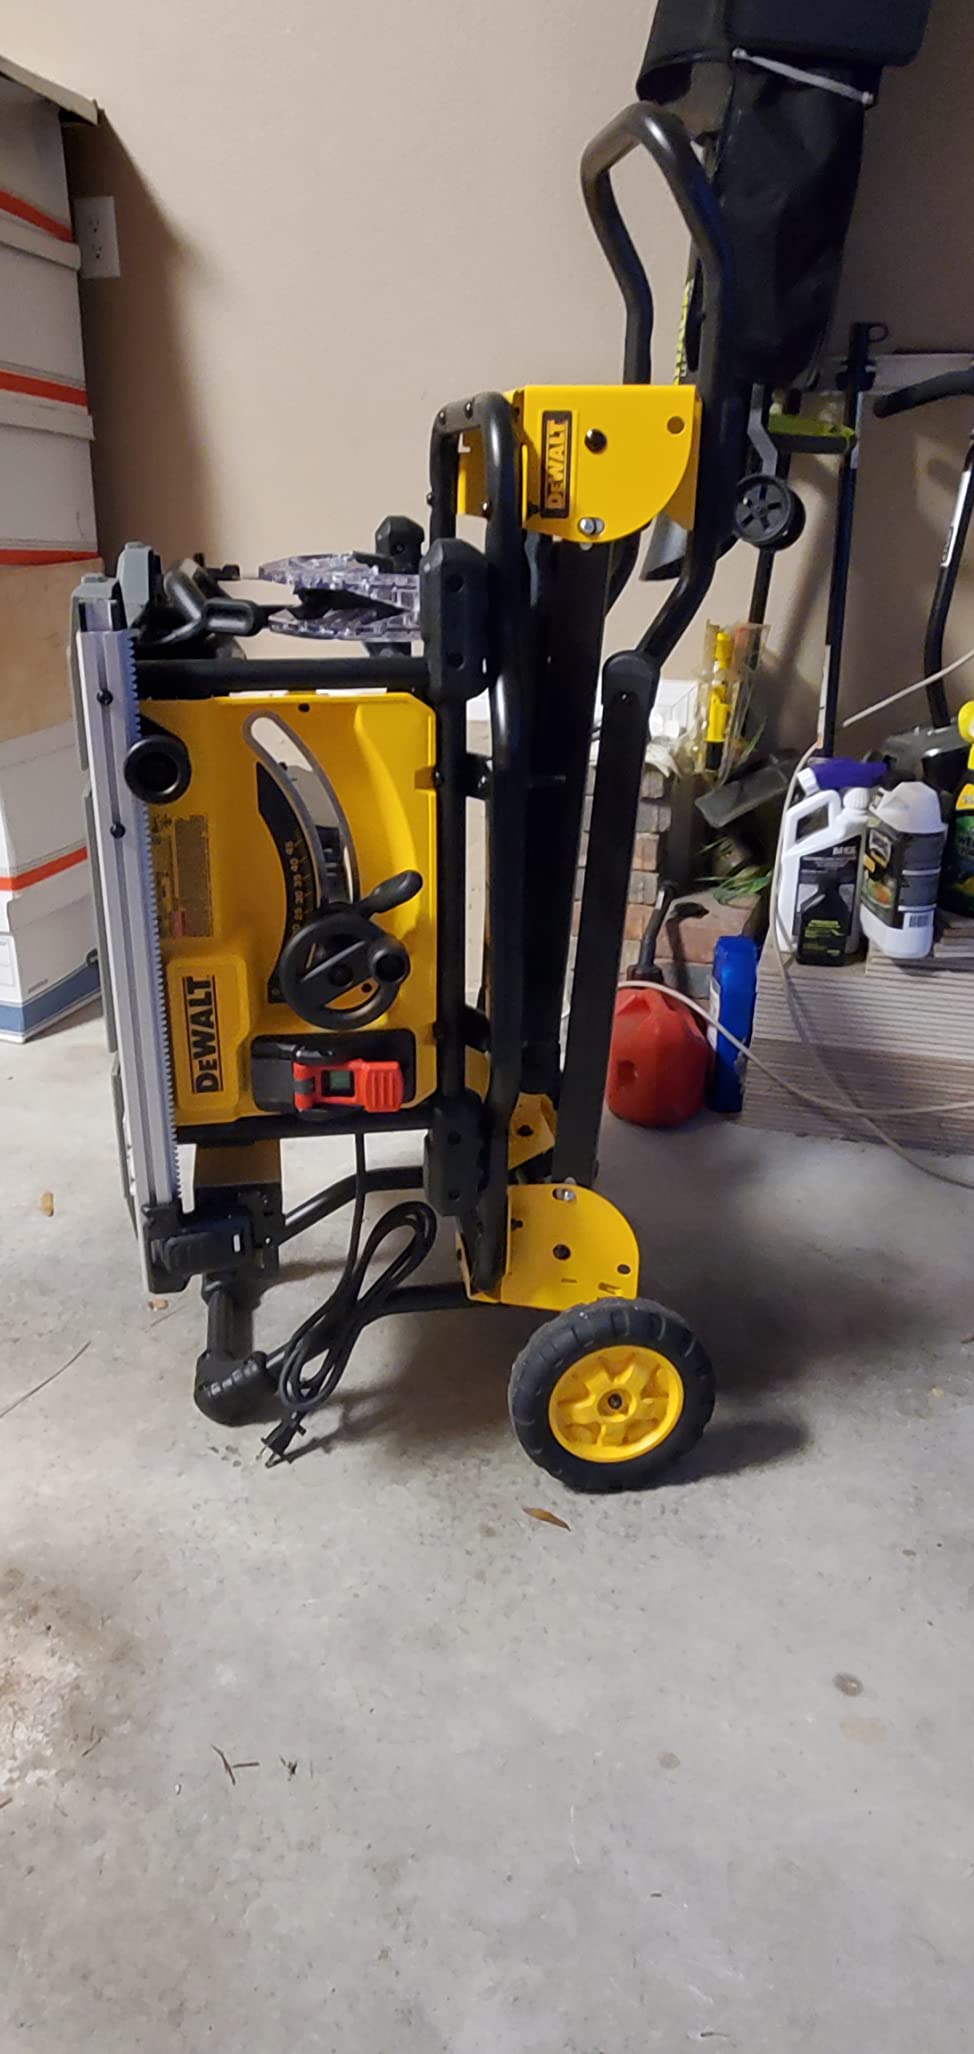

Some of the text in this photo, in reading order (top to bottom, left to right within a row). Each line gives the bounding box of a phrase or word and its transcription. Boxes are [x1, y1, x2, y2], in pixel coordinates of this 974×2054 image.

[290, 857, 299, 872] 40
[295, 890, 304, 904] 30
[186, 976, 219, 1093] DEWALT
